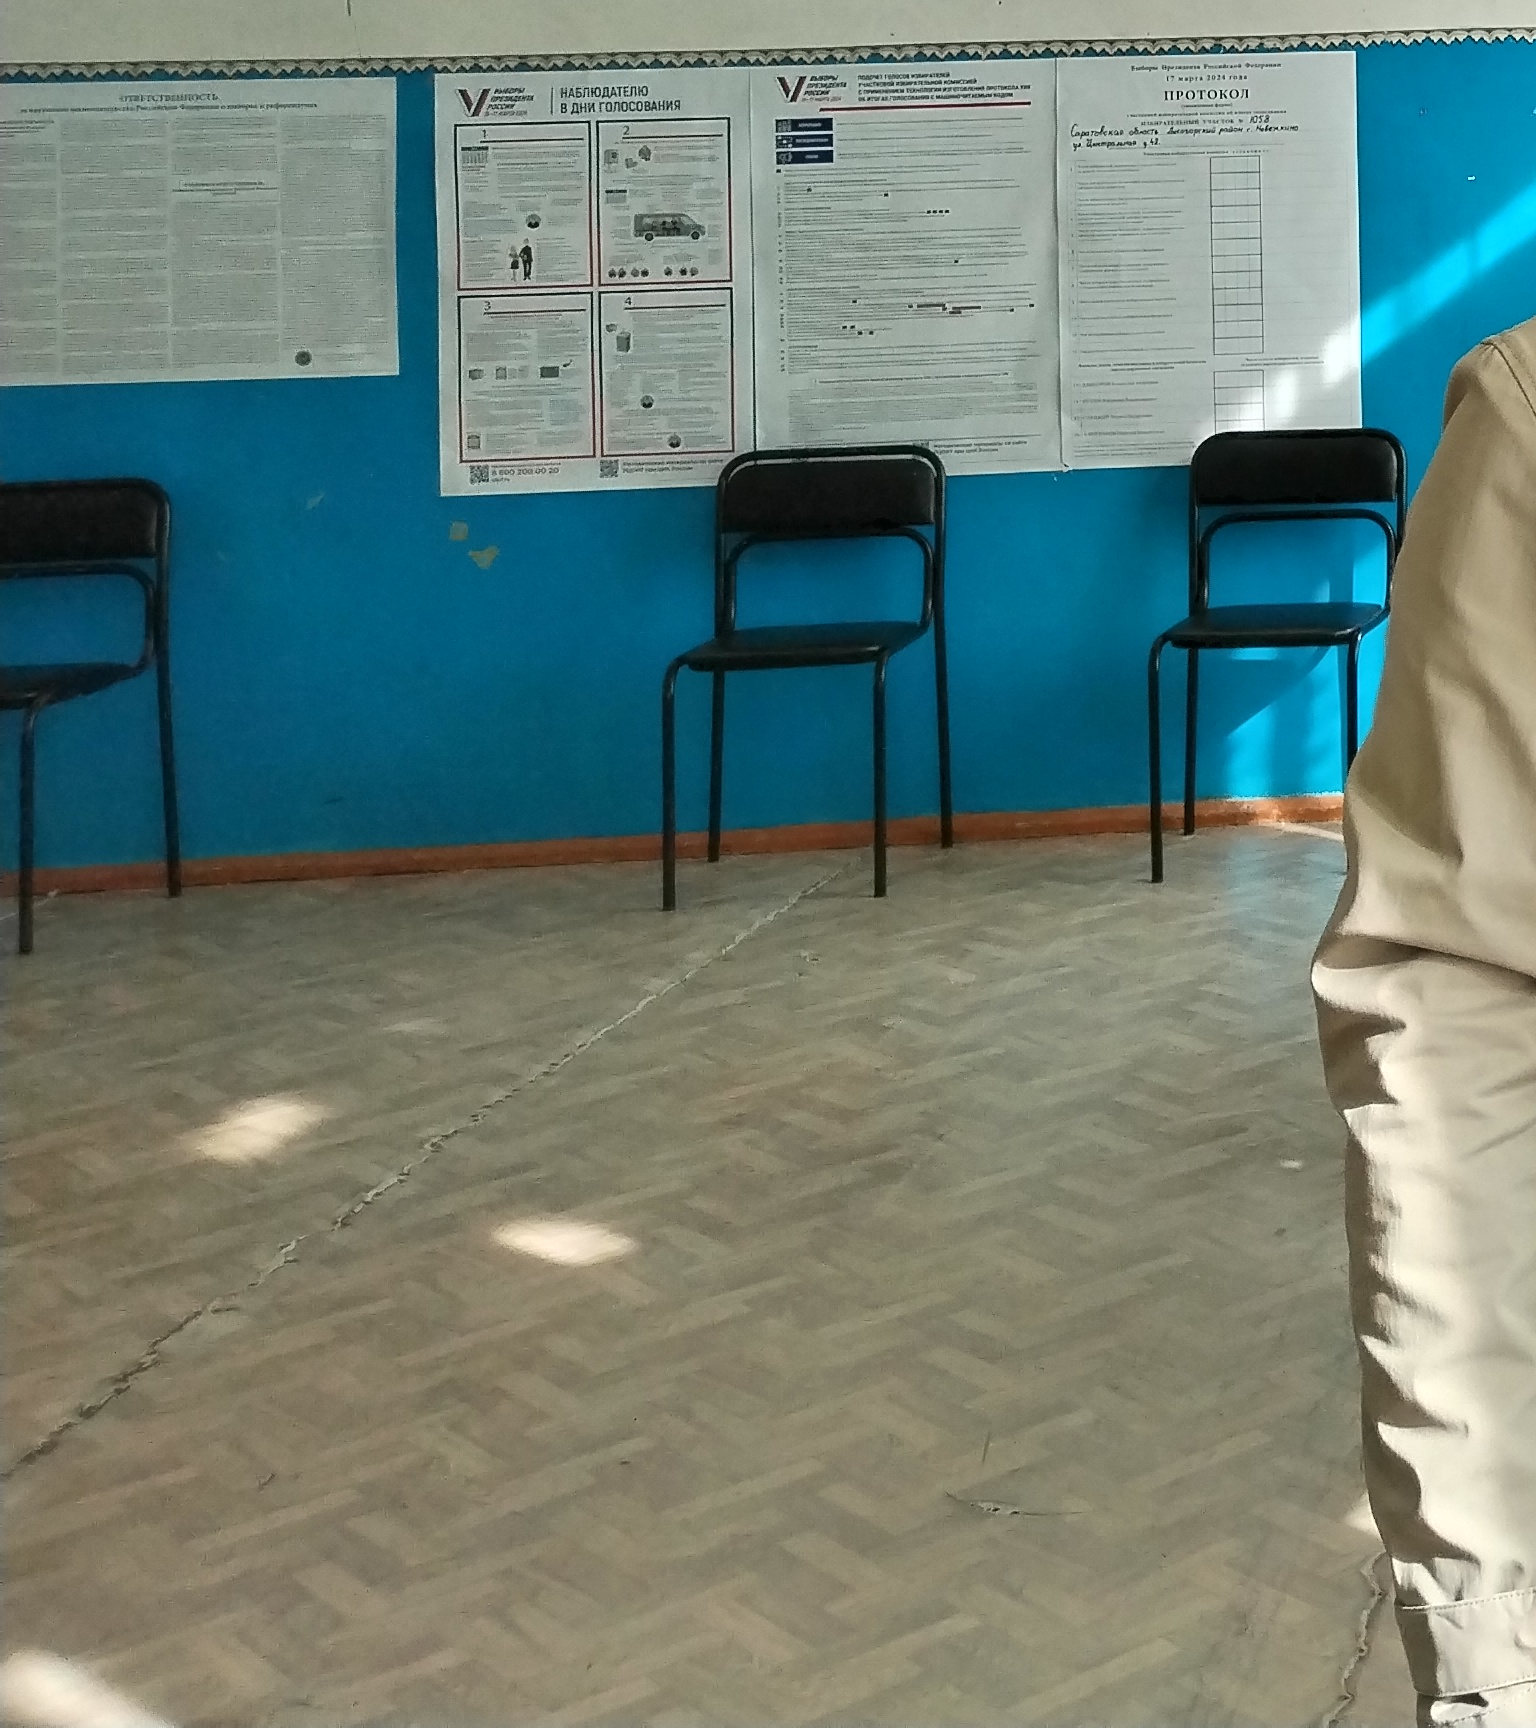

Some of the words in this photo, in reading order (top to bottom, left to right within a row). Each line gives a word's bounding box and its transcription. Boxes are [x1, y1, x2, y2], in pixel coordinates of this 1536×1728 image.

[560, 86, 649, 99] НАБЛЮДАТЕЛЮ
[1163, 88, 1250, 101] ПРОТОКОЛ
[560, 103, 567, 114] В
[570, 103, 596, 115] ДНИ
[599, 100, 682, 113] ГОЛОСОВАНИЯ
[1249, 115, 1271, 124] 1058
[481, 129, 488, 139] 1
[622, 125, 631, 135] 2
[1070, 123, 1124, 139] Саратовская
[1128, 126, 1159, 136] область
[1218, 126, 1243, 136] район
[483, 300, 492, 311] 3
[624, 296, 632, 306] 4
